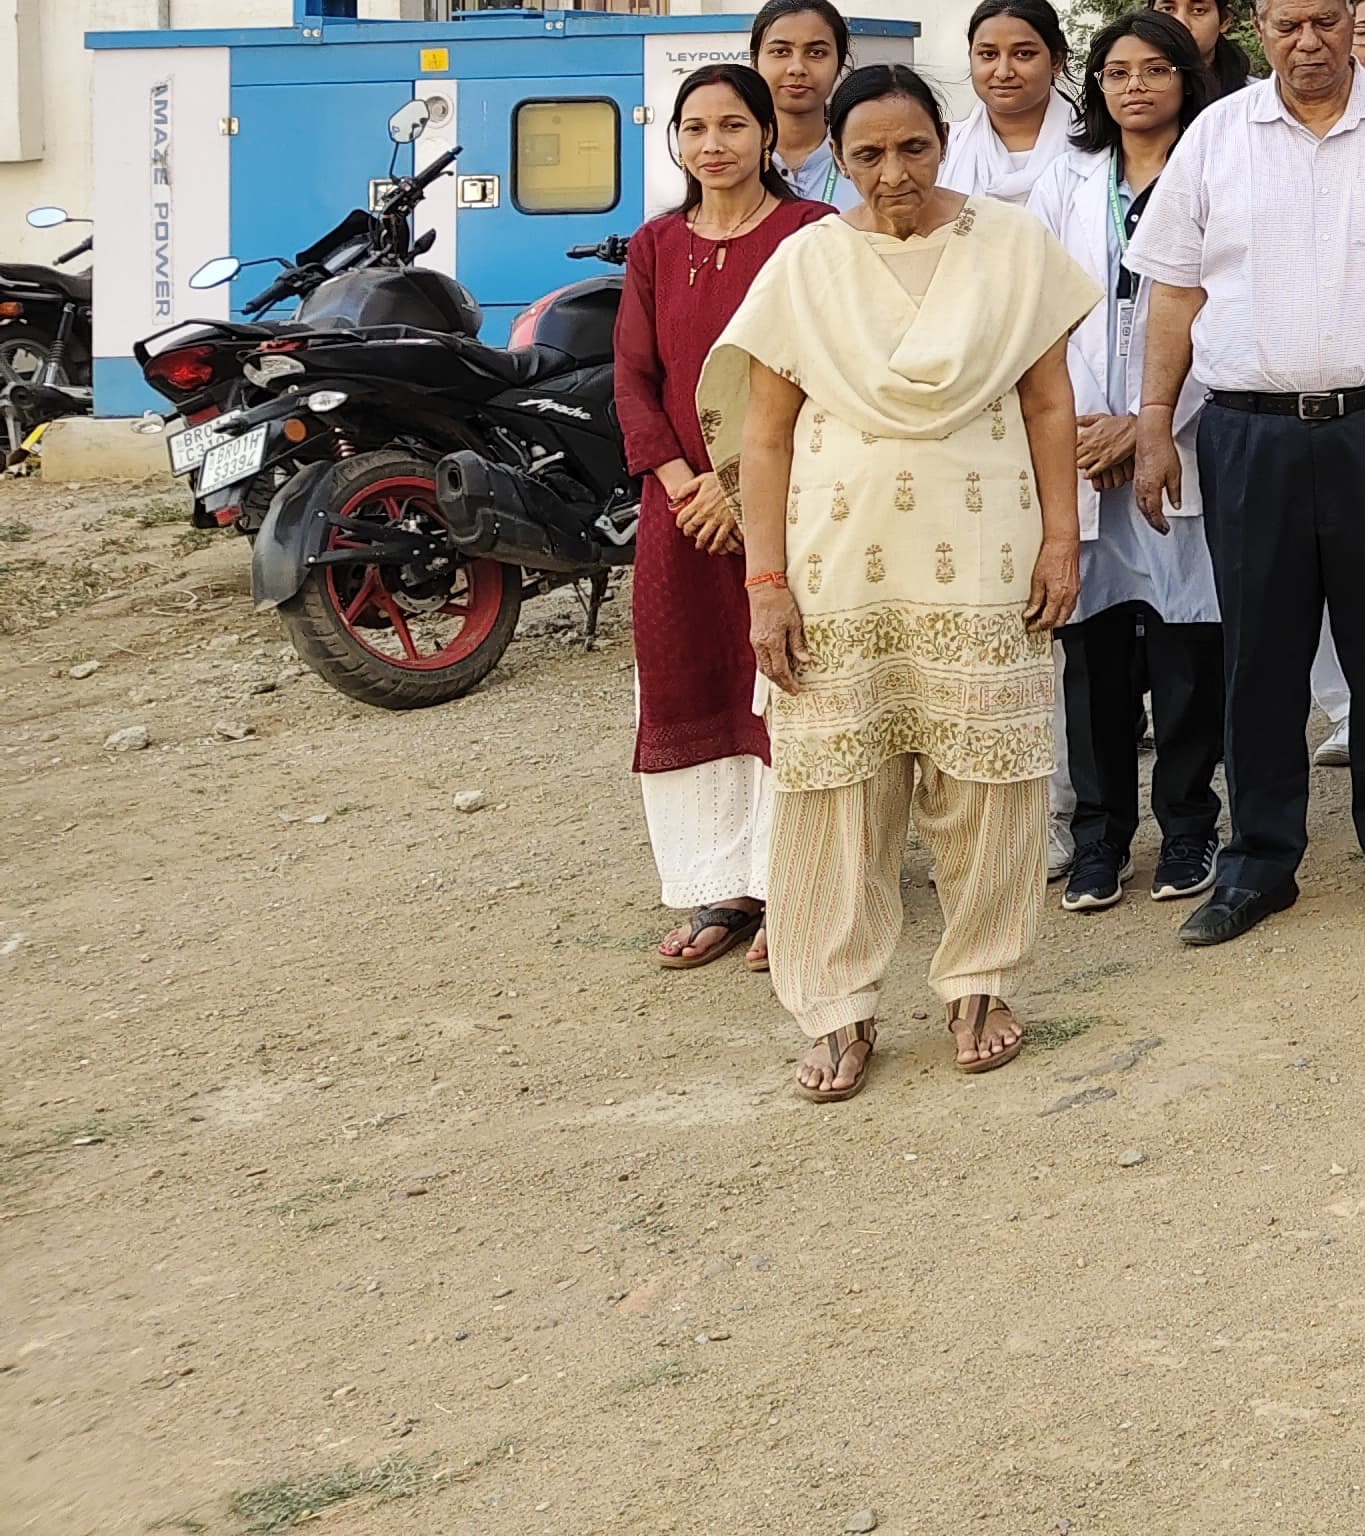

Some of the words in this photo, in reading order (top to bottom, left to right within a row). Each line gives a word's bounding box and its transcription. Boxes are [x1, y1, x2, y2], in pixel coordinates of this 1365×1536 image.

[666, 51, 751, 62] LEYPOWE
[152, 83, 169, 185] AMAZE
[154, 202, 171, 317] POWER
